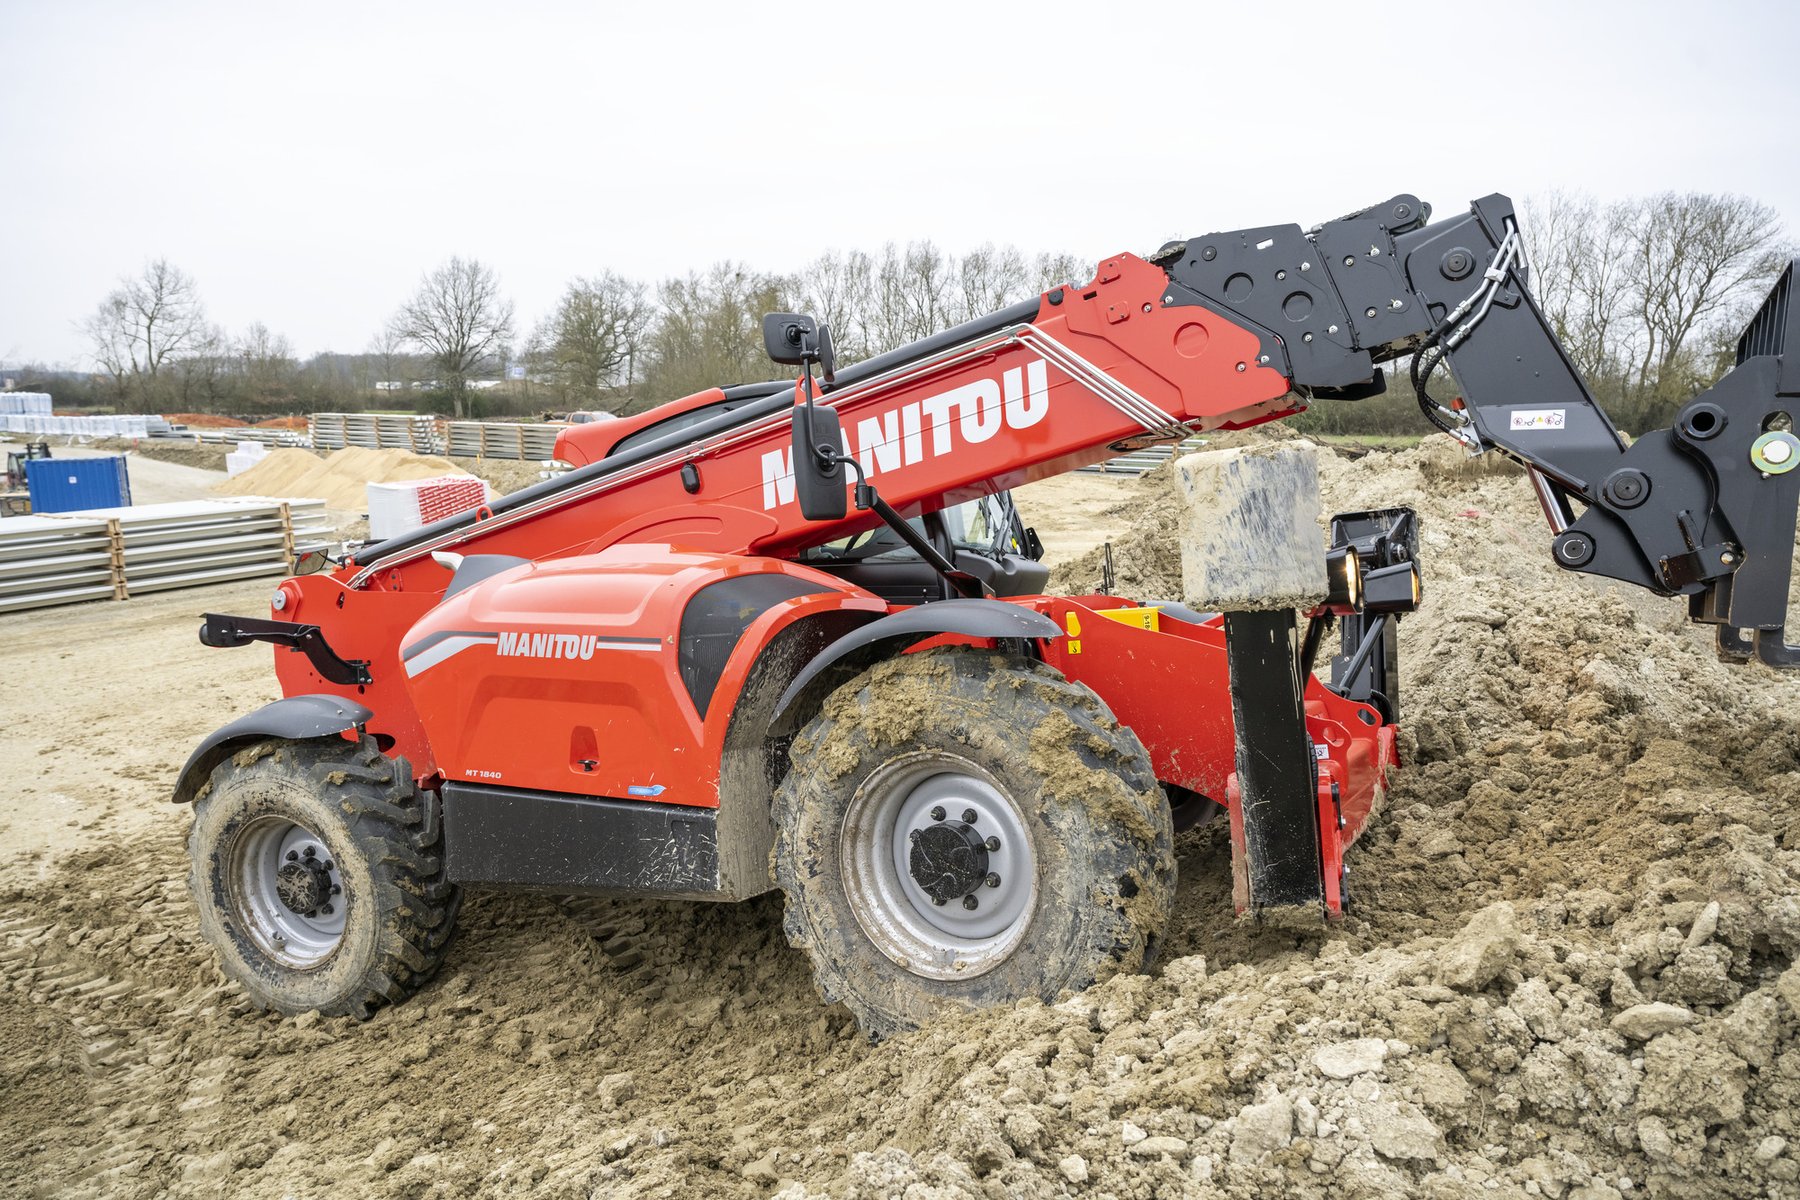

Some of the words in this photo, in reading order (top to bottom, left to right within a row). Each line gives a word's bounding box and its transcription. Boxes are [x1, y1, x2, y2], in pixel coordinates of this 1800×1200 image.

[497, 632, 596, 660] MANITOU
[465, 769, 478, 777] MT
[480, 771, 502, 779] 1840
